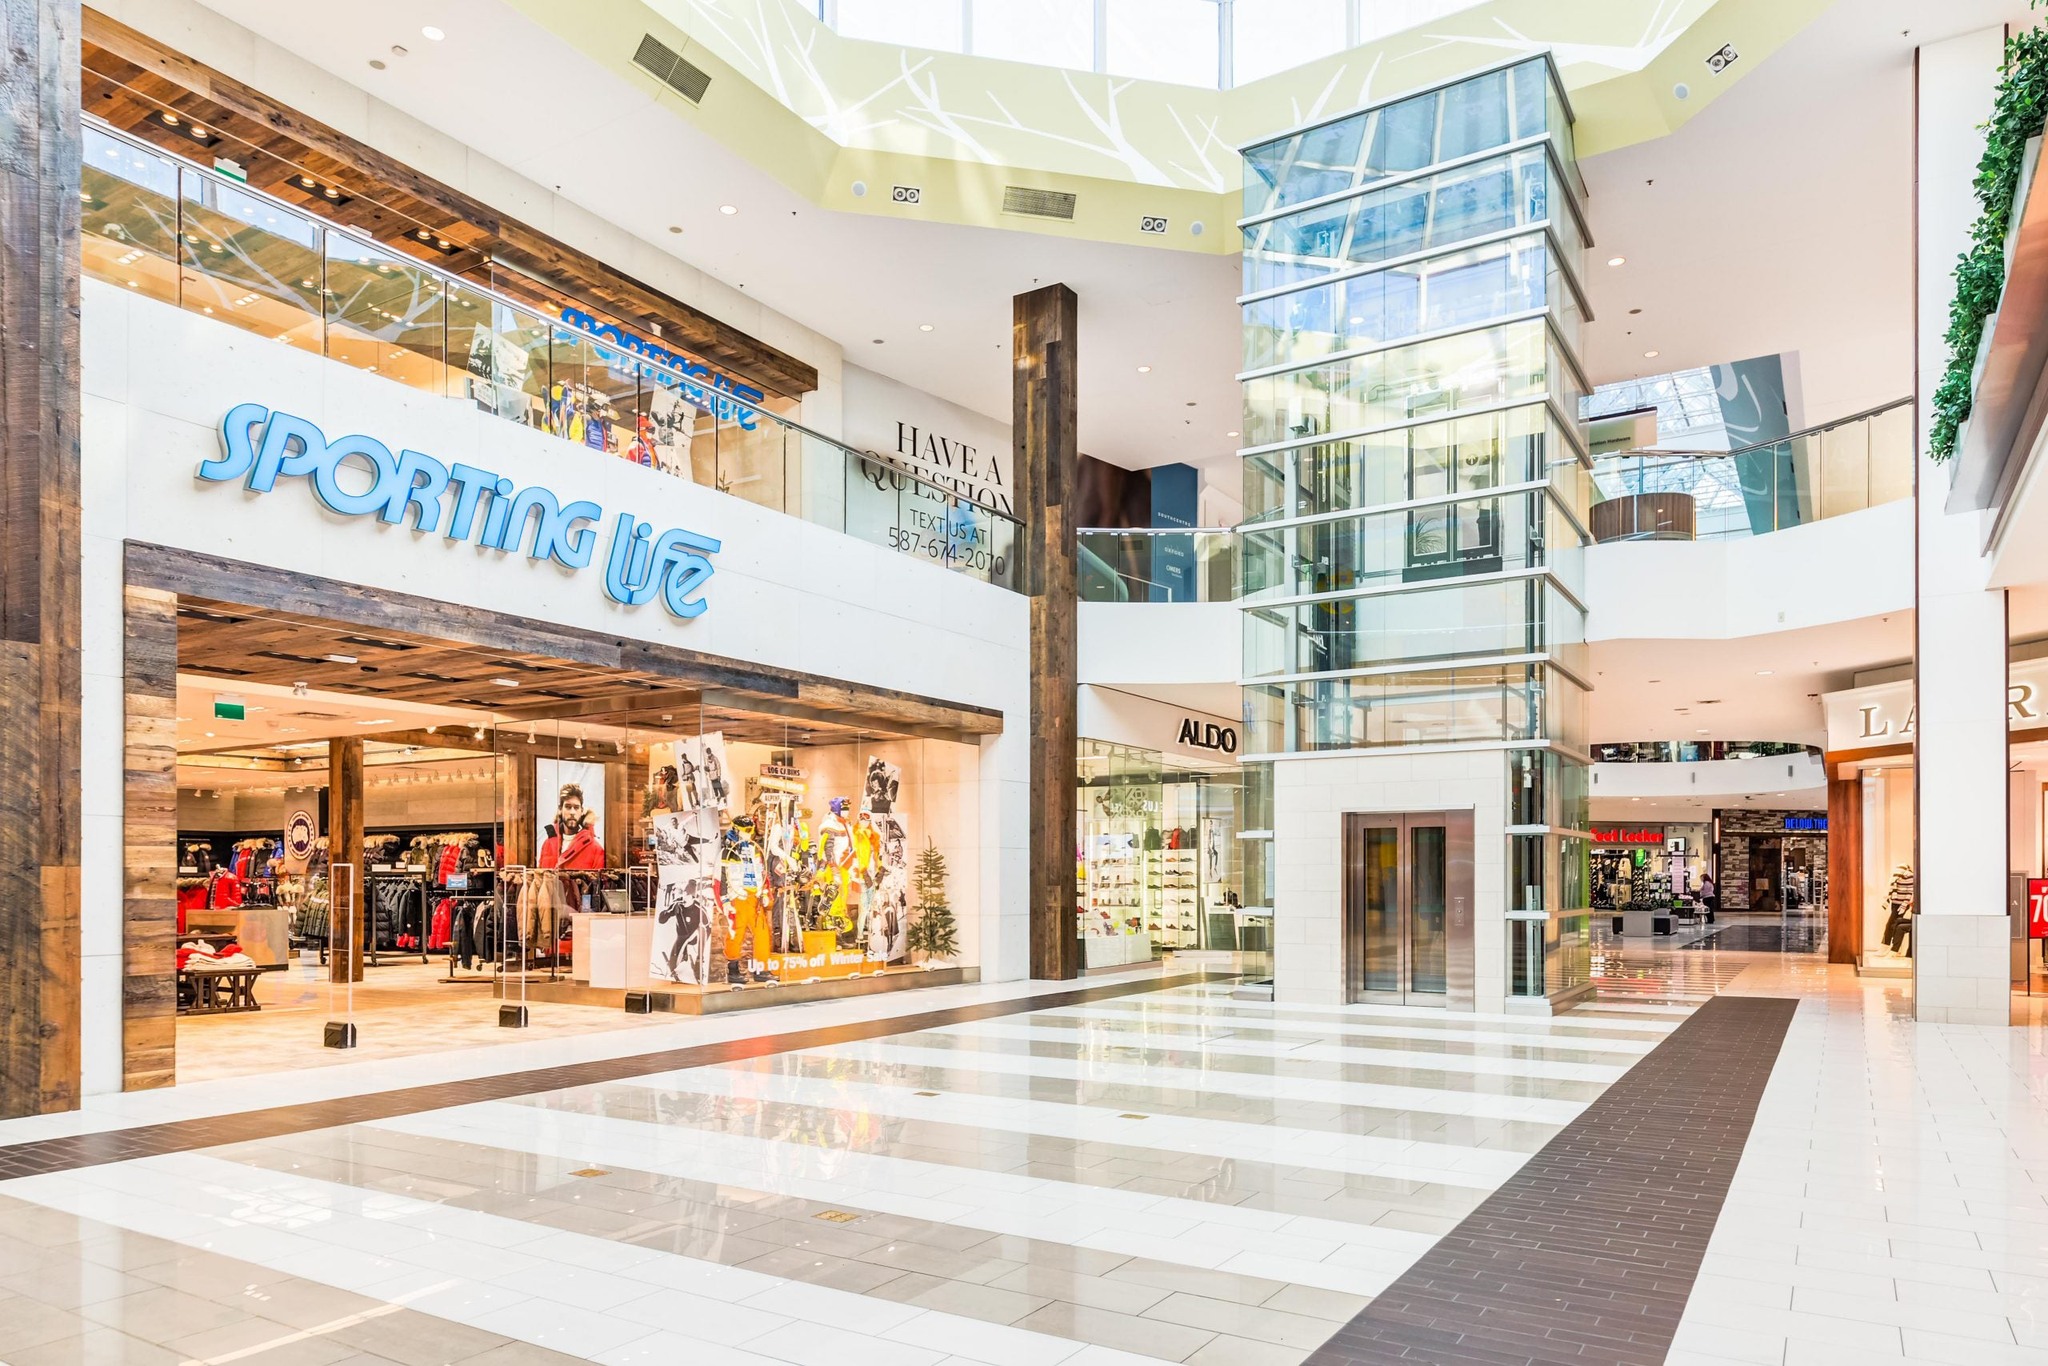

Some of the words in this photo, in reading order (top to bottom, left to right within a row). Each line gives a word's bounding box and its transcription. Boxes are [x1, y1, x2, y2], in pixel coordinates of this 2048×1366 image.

[895, 420, 978, 478] HAVE
[984, 455, 1003, 487] A
[909, 508, 946, 533] TEXT
[949, 519, 967, 540] US
[969, 528, 987, 545] AT
[1157, 511, 1191, 527] SOUTHCENTRE
[888, 526, 1006, 576] 587-674-2070
[1164, 546, 1184, 557] OXFORD
[1177, 718, 1237, 753] ALDO
[767, 766, 778, 774] LOG
[1785, 817, 1812, 829] BELOW
[1621, 828, 1663, 843] Locker
[747, 958, 764, 975] Up
[767, 959, 779, 972] to
[782, 956, 807, 970] 75%
[809, 953, 826, 968] off
[830, 952, 864, 965] Winter
[866, 950, 889, 963] Sale
